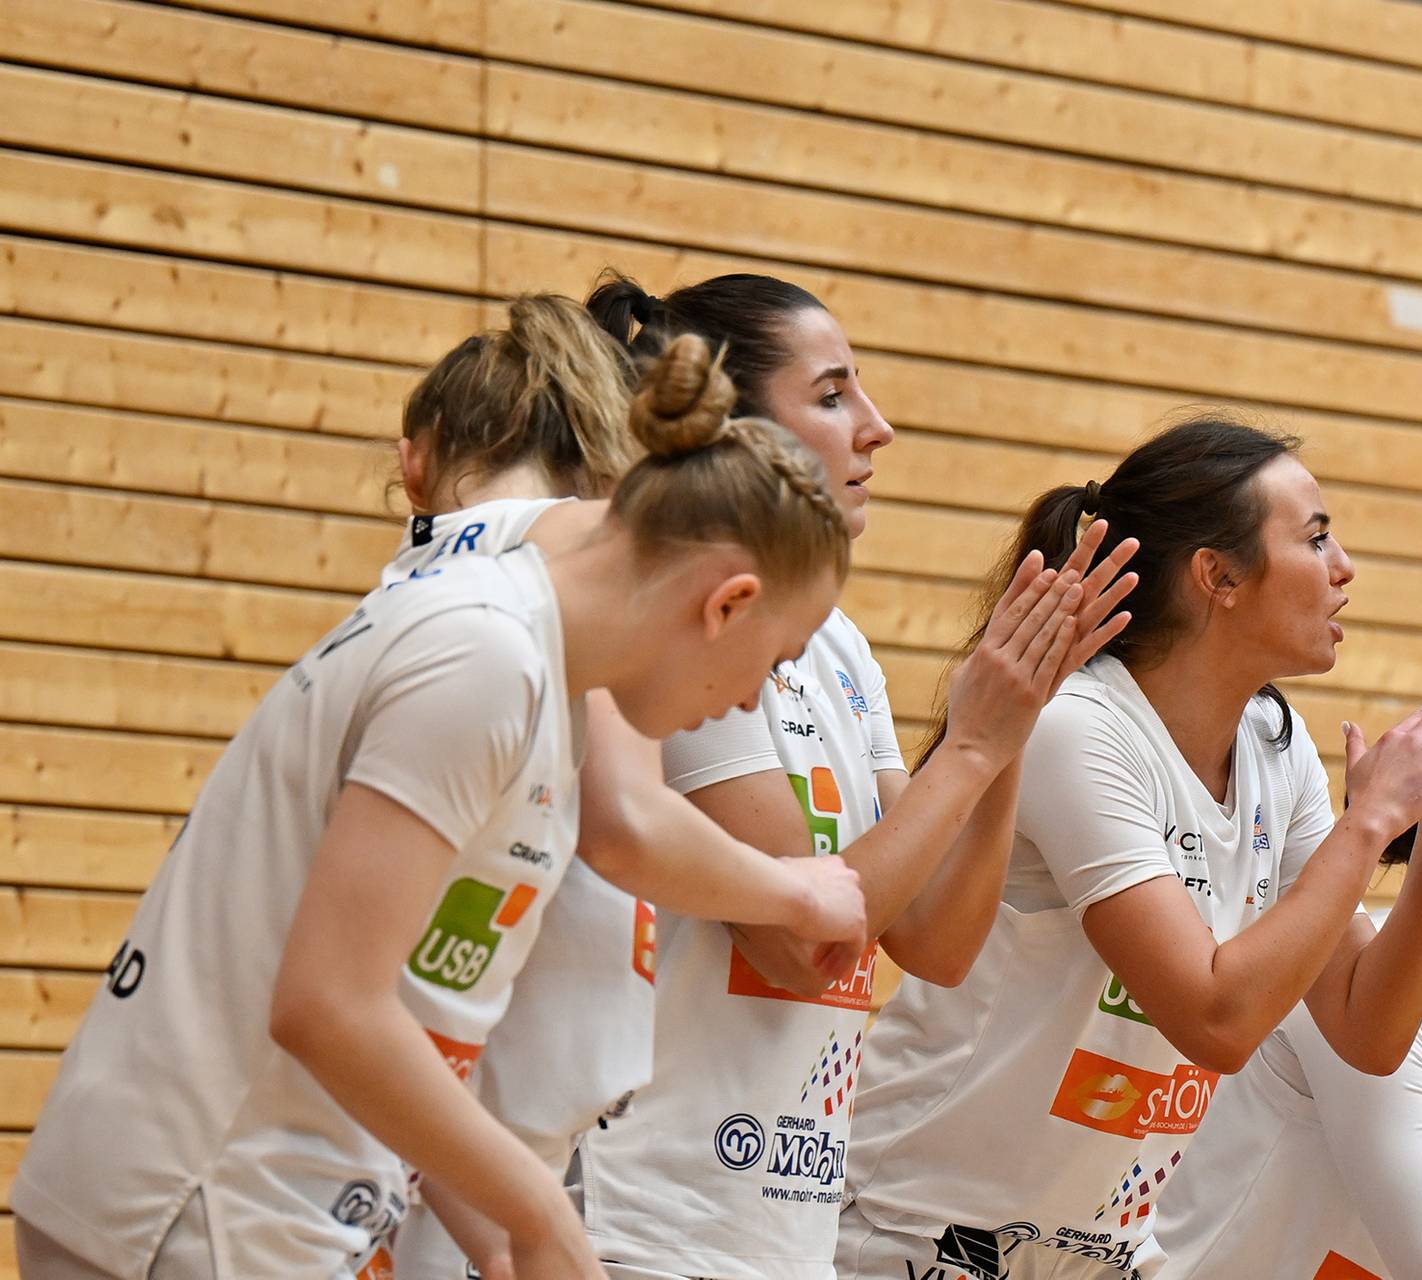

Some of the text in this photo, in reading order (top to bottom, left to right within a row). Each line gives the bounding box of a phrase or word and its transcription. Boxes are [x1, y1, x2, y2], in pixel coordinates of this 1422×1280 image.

[416, 927, 493, 986] USB
[776, 1115, 816, 1131] GERHARD
[1055, 1227, 1112, 1244] GERHARD
